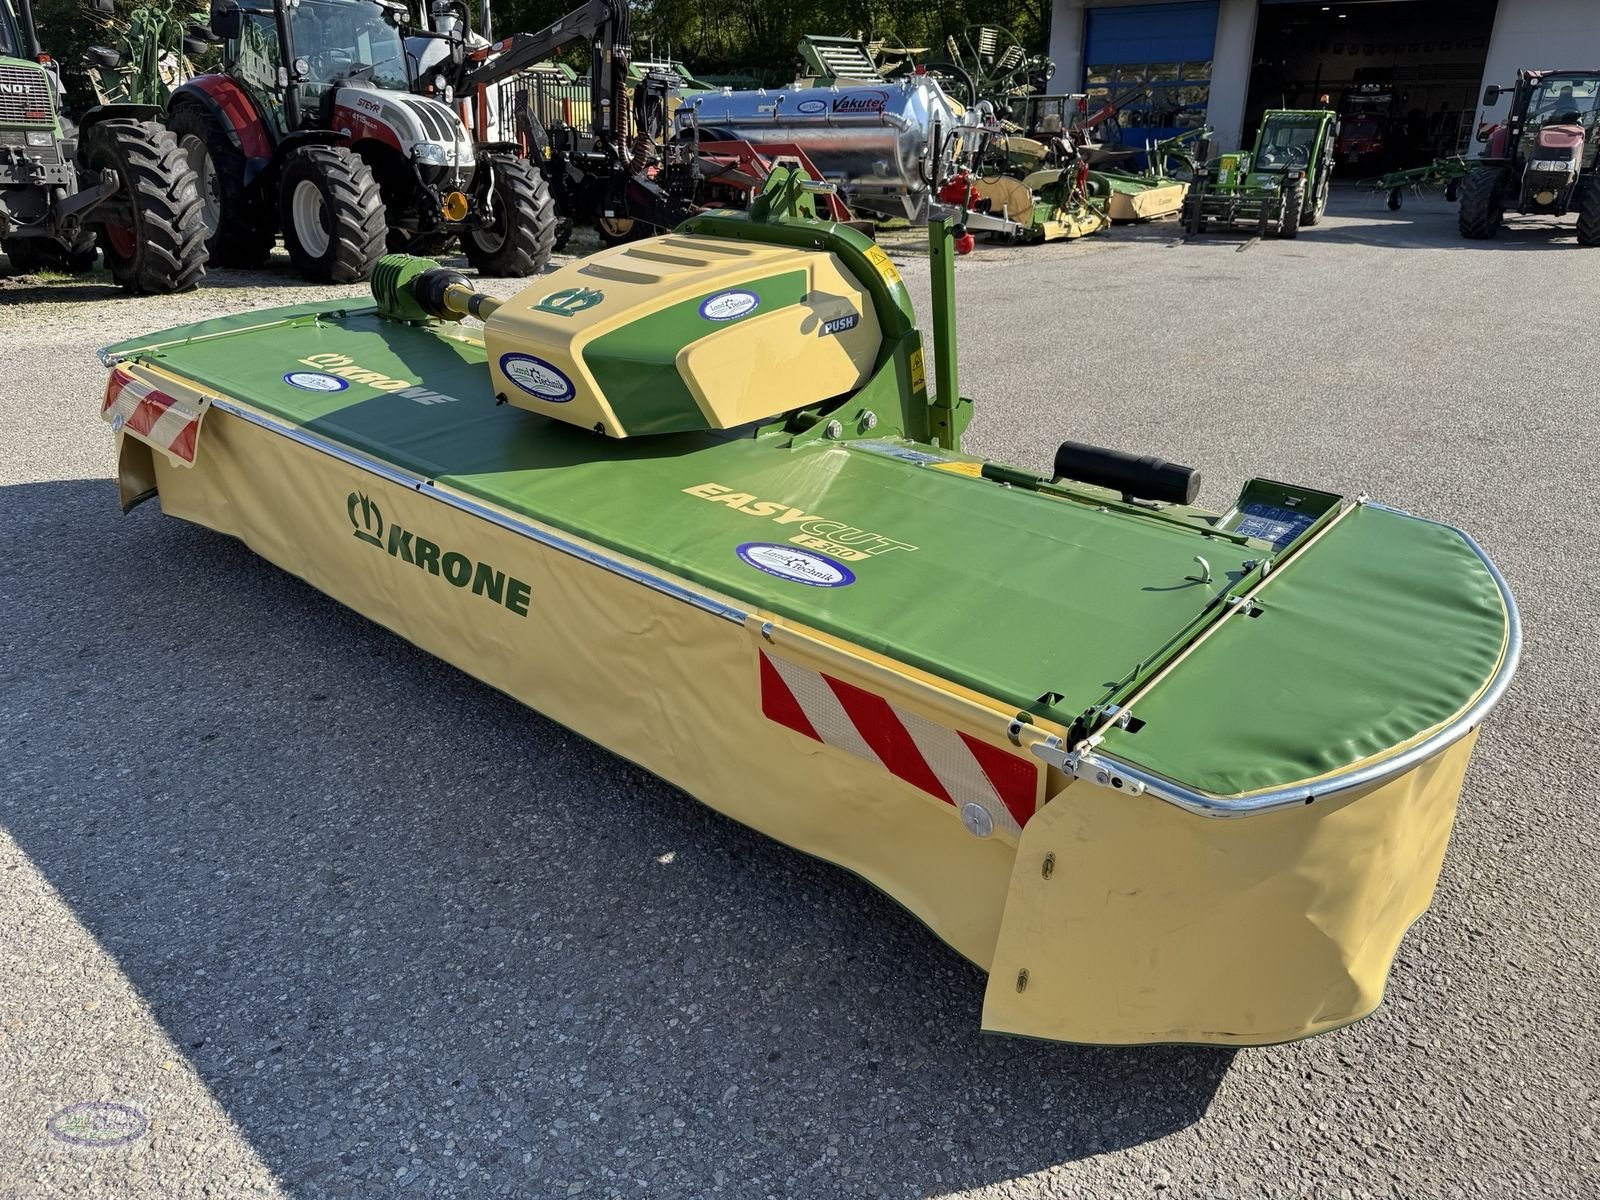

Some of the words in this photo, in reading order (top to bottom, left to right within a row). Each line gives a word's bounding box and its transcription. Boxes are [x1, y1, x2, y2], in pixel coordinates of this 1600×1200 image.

[356, 98, 380, 113] STEYR
[352, 112, 367, 124] 4115
[825, 316, 853, 334] PUSH
[325, 365, 460, 406] KRONE
[799, 537, 817, 545] F
[816, 542, 857, 558] 360
[387, 523, 532, 618] KRONE
[763, 549, 792, 561] Land
[792, 563, 834, 582] Technik
